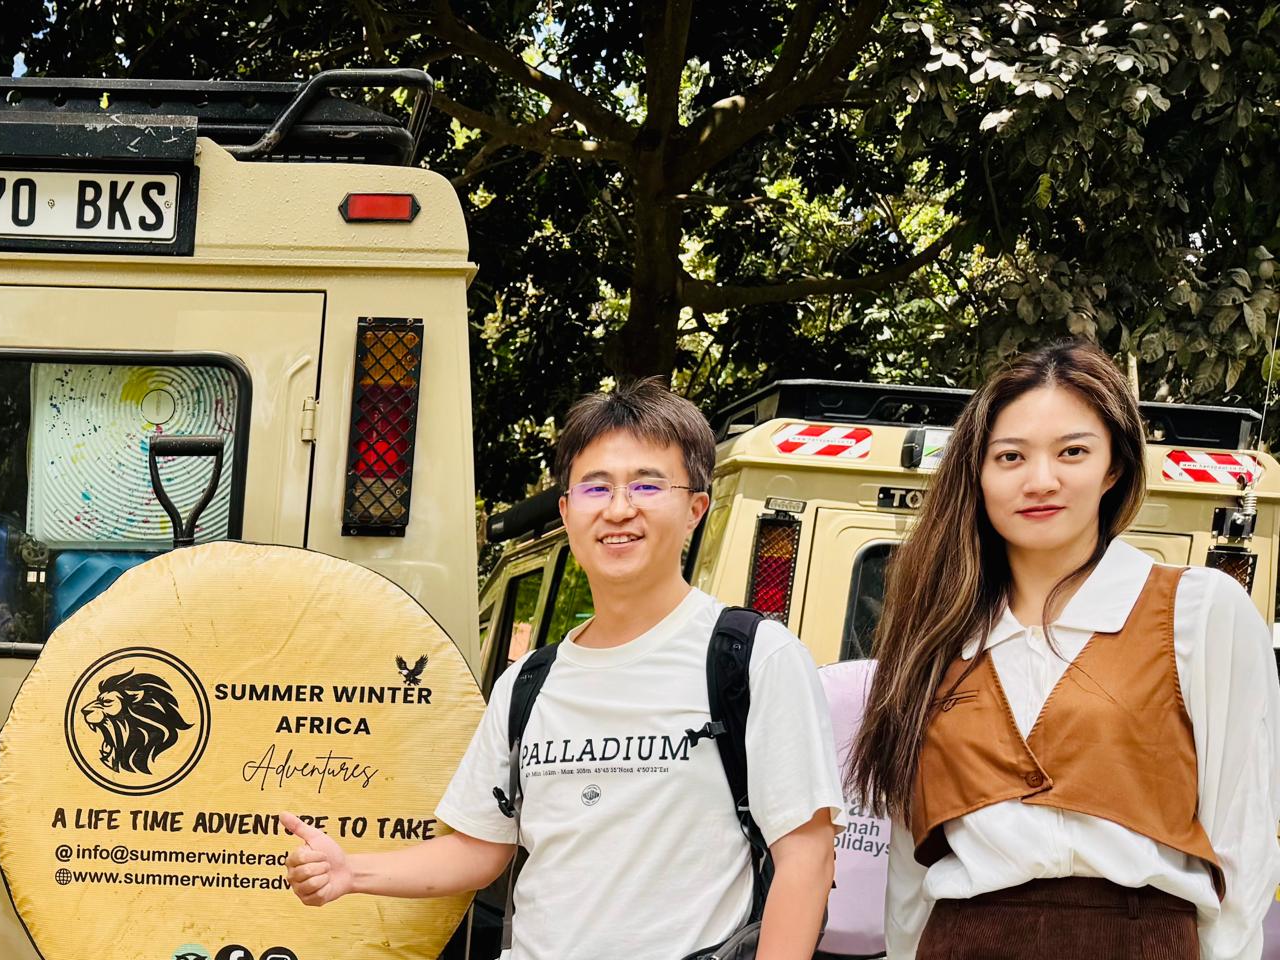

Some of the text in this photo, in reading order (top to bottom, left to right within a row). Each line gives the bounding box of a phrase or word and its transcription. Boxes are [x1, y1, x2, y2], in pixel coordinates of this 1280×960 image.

[75, 179, 166, 231] BKS
[214, 683, 433, 704] SUMMER WINTER
[275, 715, 371, 735] AFRICA
[242, 743, 378, 793] Adventures
[521, 735, 690, 769] PALLADIUM
[51, 807, 437, 840] A LIFE TIME ADVENTRE TO TAKE
